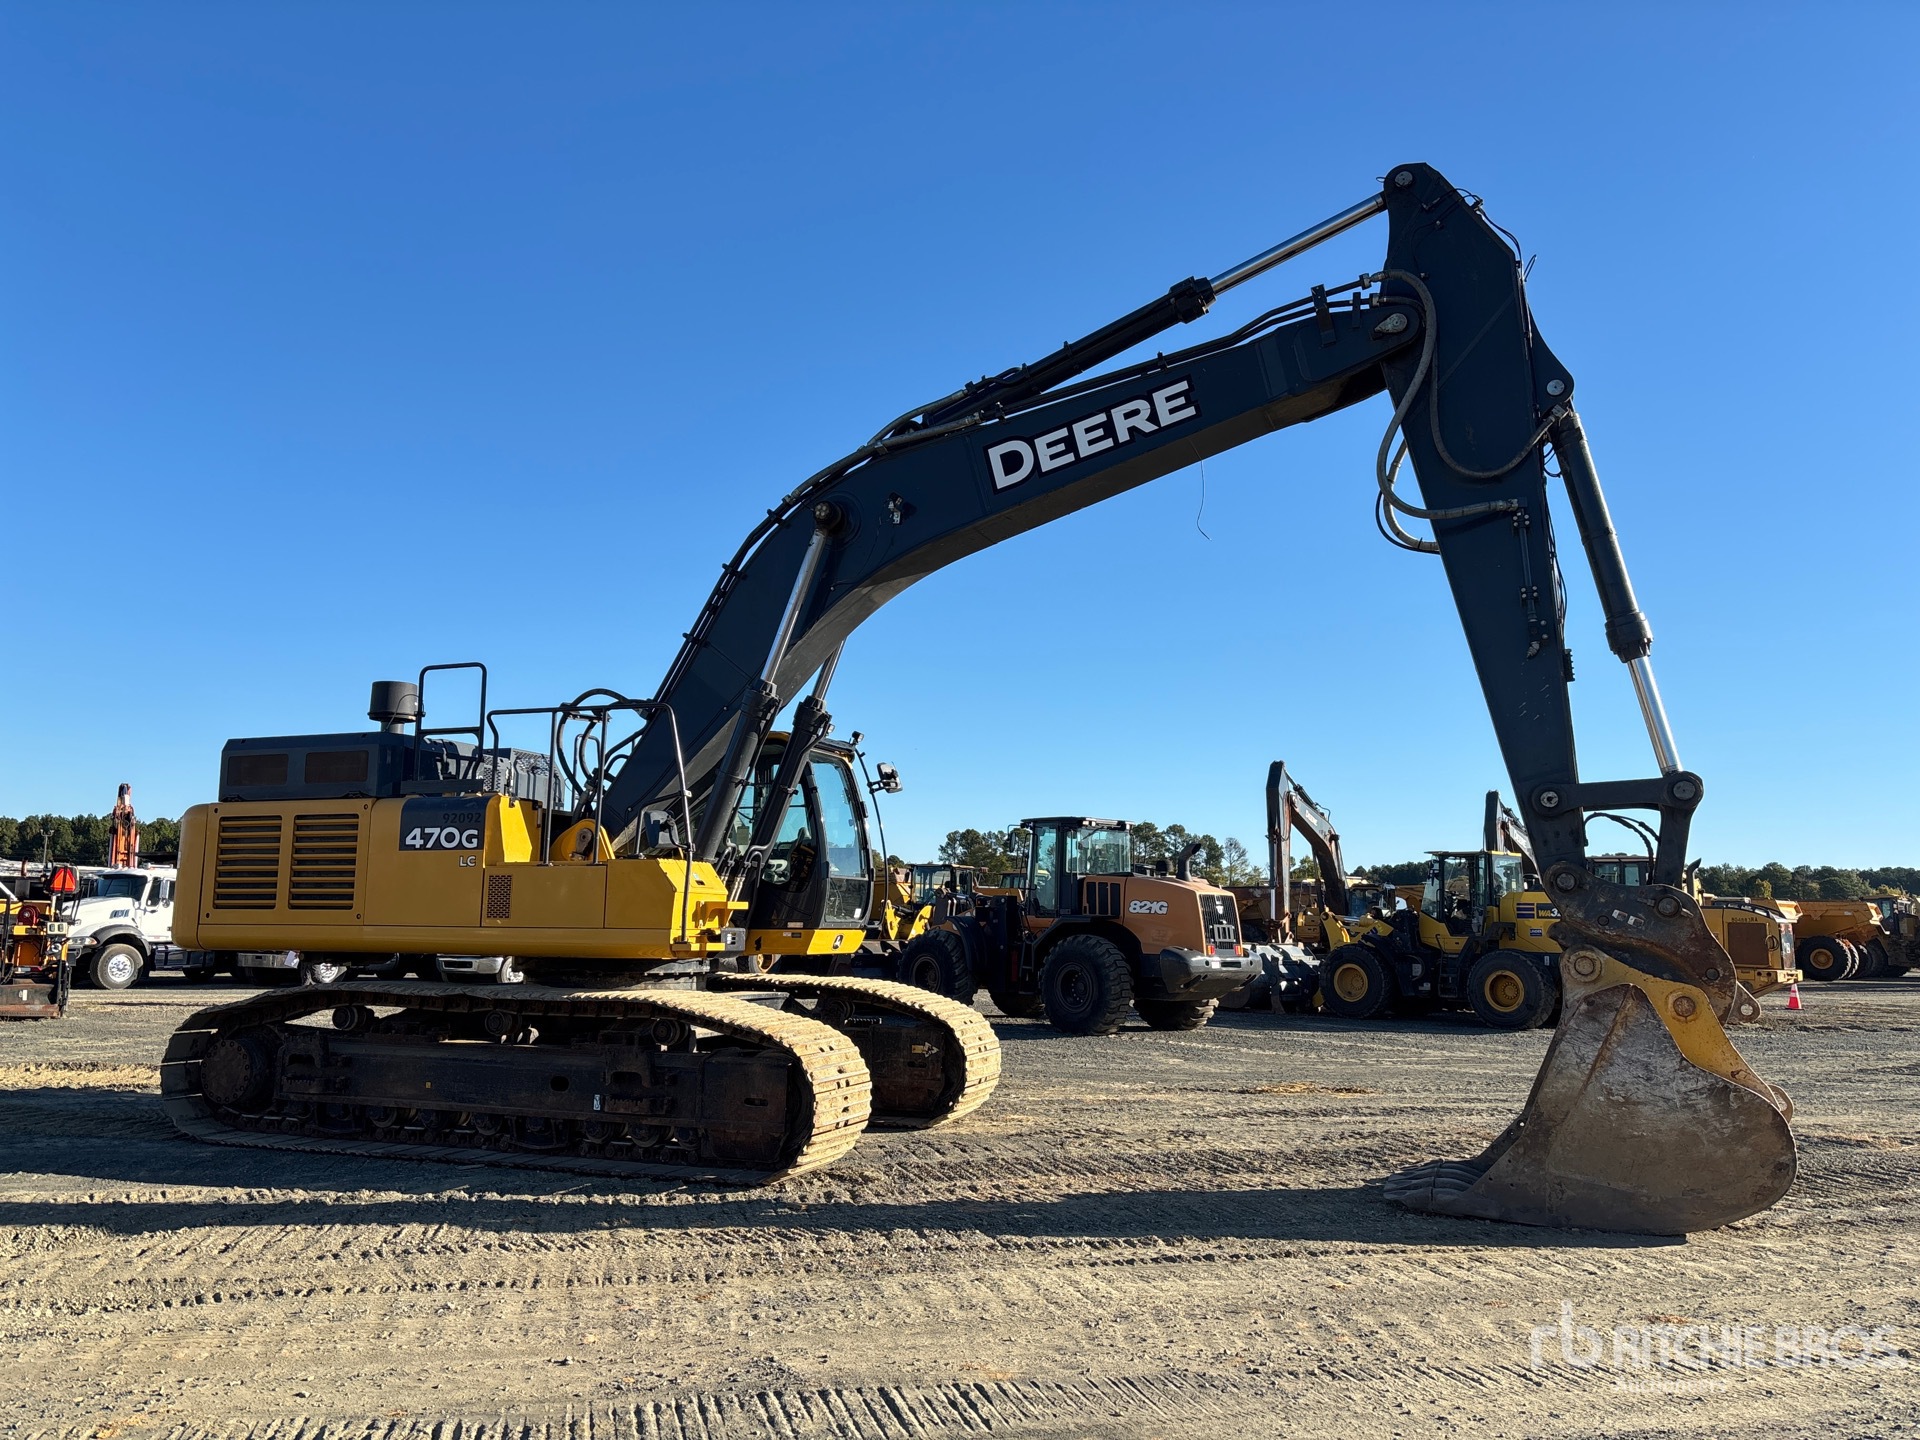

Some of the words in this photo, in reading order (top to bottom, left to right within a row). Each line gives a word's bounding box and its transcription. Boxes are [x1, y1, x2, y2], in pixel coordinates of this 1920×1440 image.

[988, 380, 1197, 489] DEERE
[443, 813, 481, 824] 92092
[405, 827, 478, 849] 470G
[459, 856, 476, 867] LC
[1129, 900, 1168, 914] 821G
